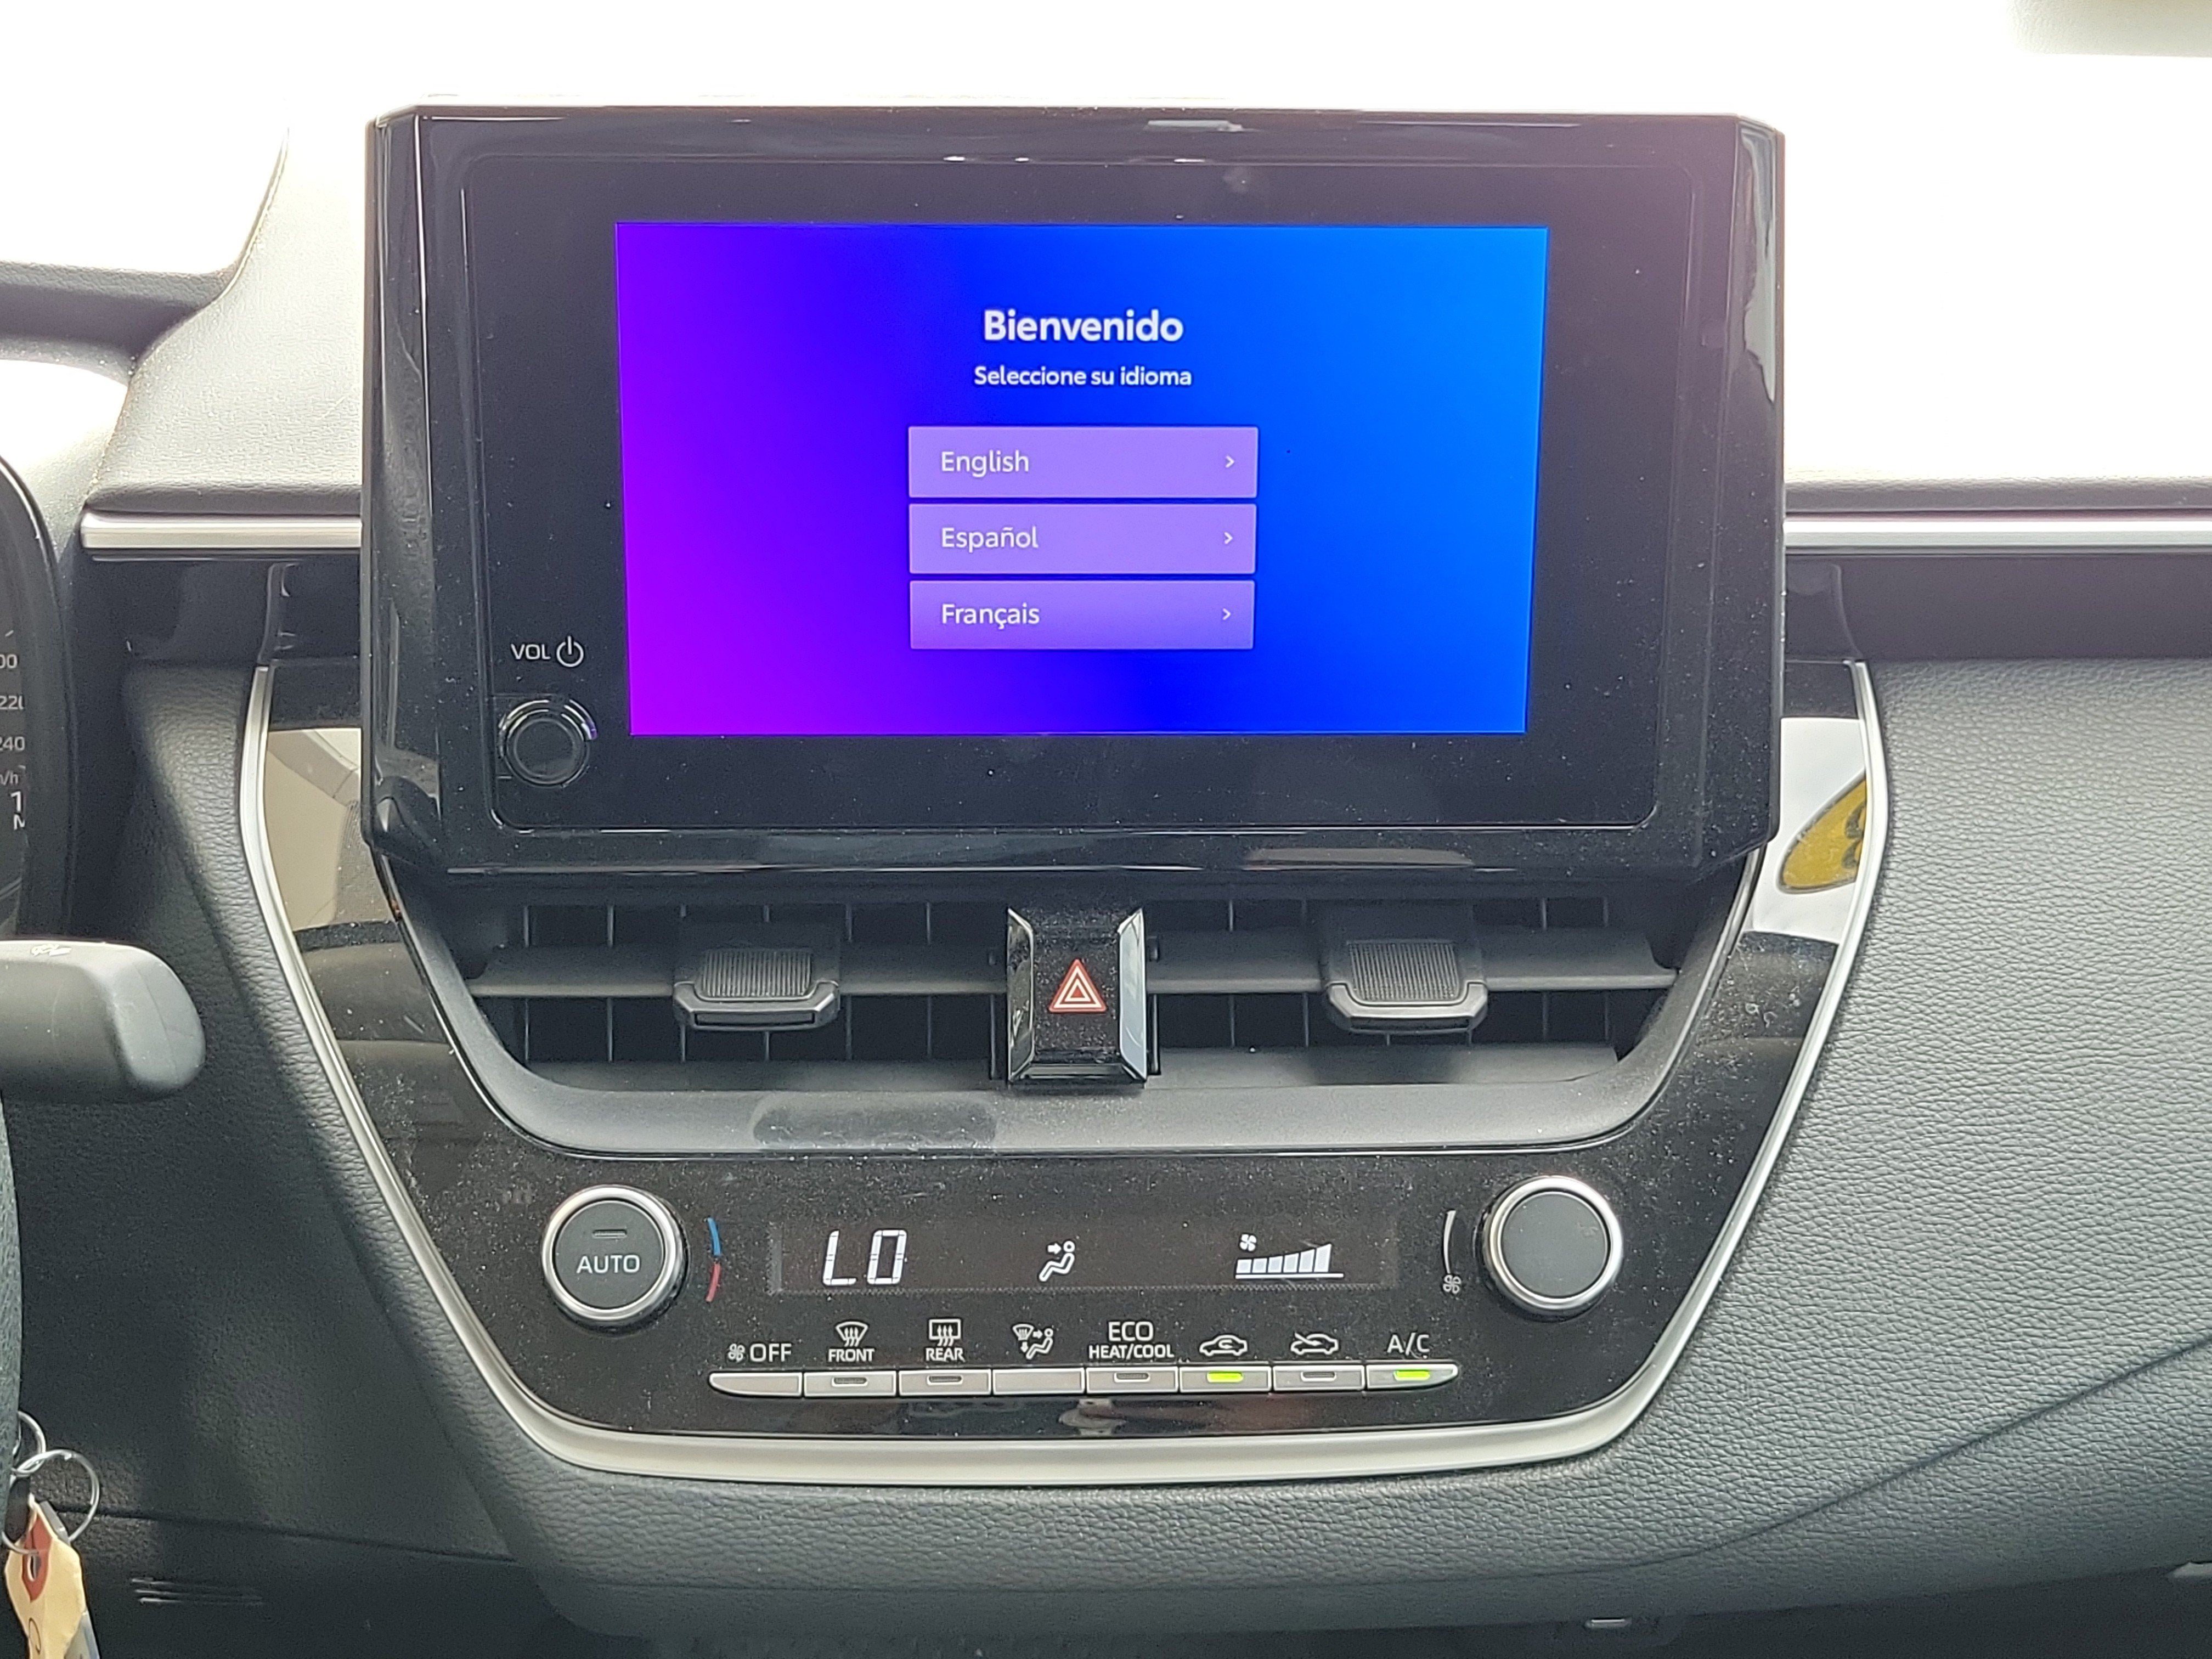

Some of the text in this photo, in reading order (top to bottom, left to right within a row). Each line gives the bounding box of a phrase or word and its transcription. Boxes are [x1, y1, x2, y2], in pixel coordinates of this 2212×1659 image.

[984, 309, 1184, 342] Bienvenido
[974, 365, 1192, 385] Seleccione su idioma
[941, 450, 1029, 477] English
[941, 526, 1039, 553] Español
[942, 603, 1040, 630] Français
[511, 644, 551, 659] VOL
[0, 736, 25, 751] 40
[576, 1254, 640, 1274] AUTO
[823, 1230, 907, 1286] LO
[1108, 1321, 1154, 1342] ECO
[749, 1343, 792, 1363] OFF
[1088, 1343, 1175, 1359] HEAT/COOL
[1386, 1332, 1430, 1356] A/C
[828, 1348, 876, 1362] FRONT
[926, 1348, 964, 1362] REAR
